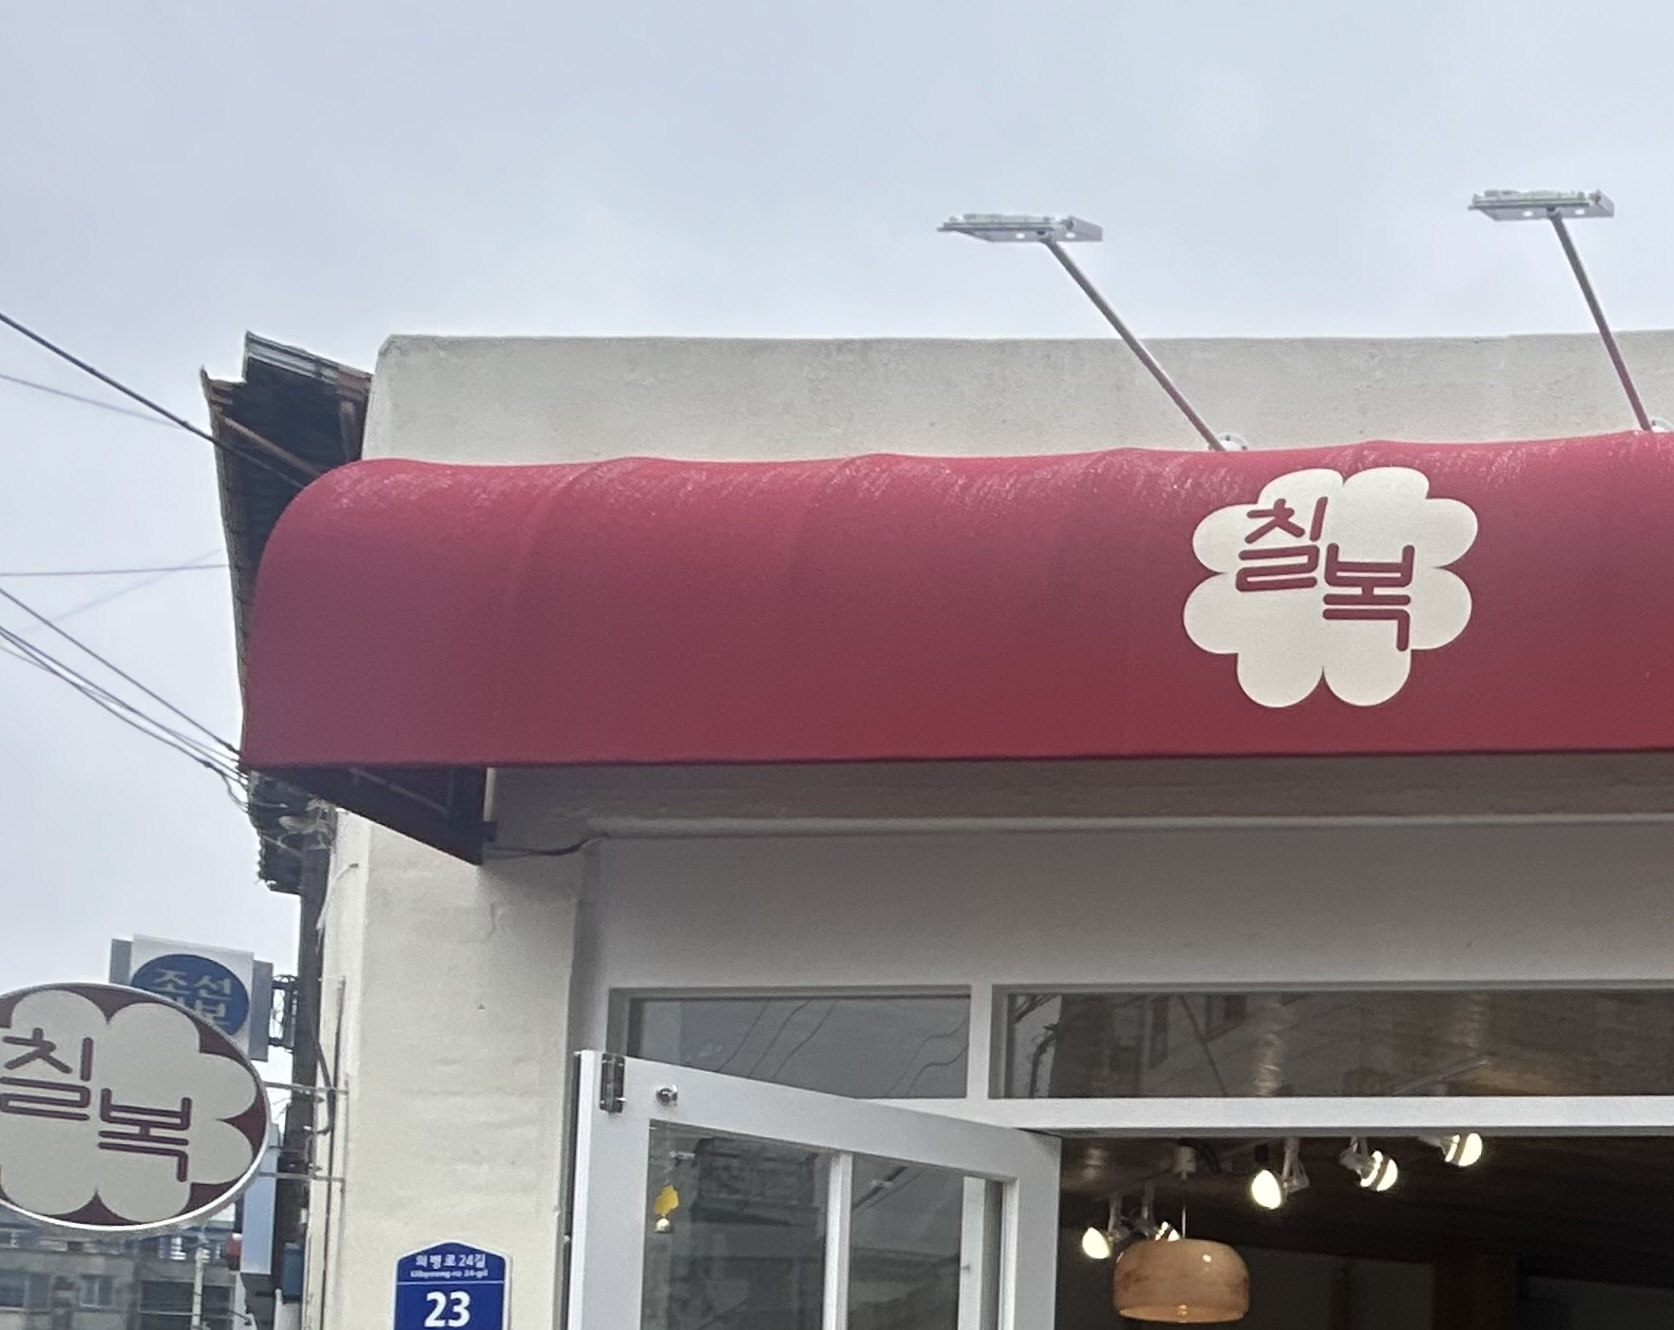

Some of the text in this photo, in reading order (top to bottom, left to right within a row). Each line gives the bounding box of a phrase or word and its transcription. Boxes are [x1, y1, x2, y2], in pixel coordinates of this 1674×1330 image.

[1235, 496, 1415, 652] 칠복
[0, 1027, 192, 1182] 칠복
[424, 1290, 471, 1328] 23
